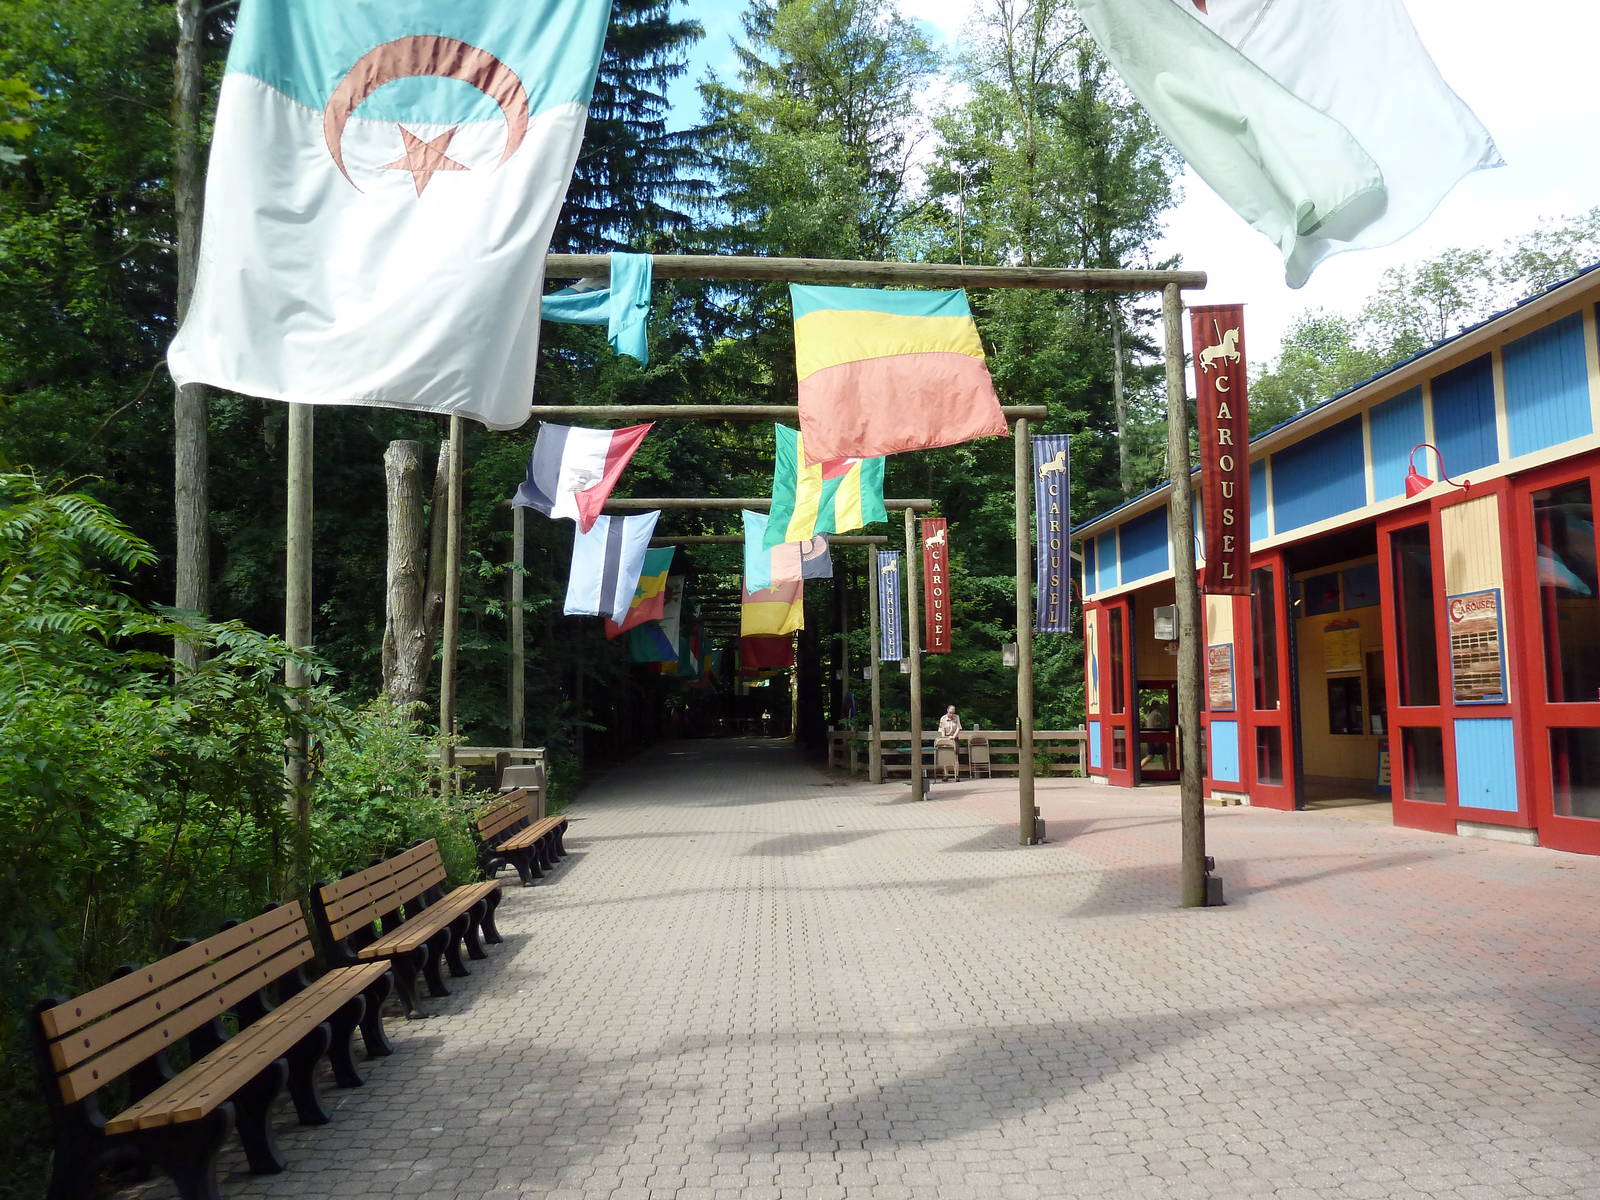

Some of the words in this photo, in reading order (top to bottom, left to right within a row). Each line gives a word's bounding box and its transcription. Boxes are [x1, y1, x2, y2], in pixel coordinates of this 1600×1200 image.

[1215, 375, 1234, 580] CAROUSEL
[931, 550, 943, 646] CAROUSEL
[1048, 484, 1061, 623] CAROUSEL
[886, 577, 895, 656] CAROUSEL
